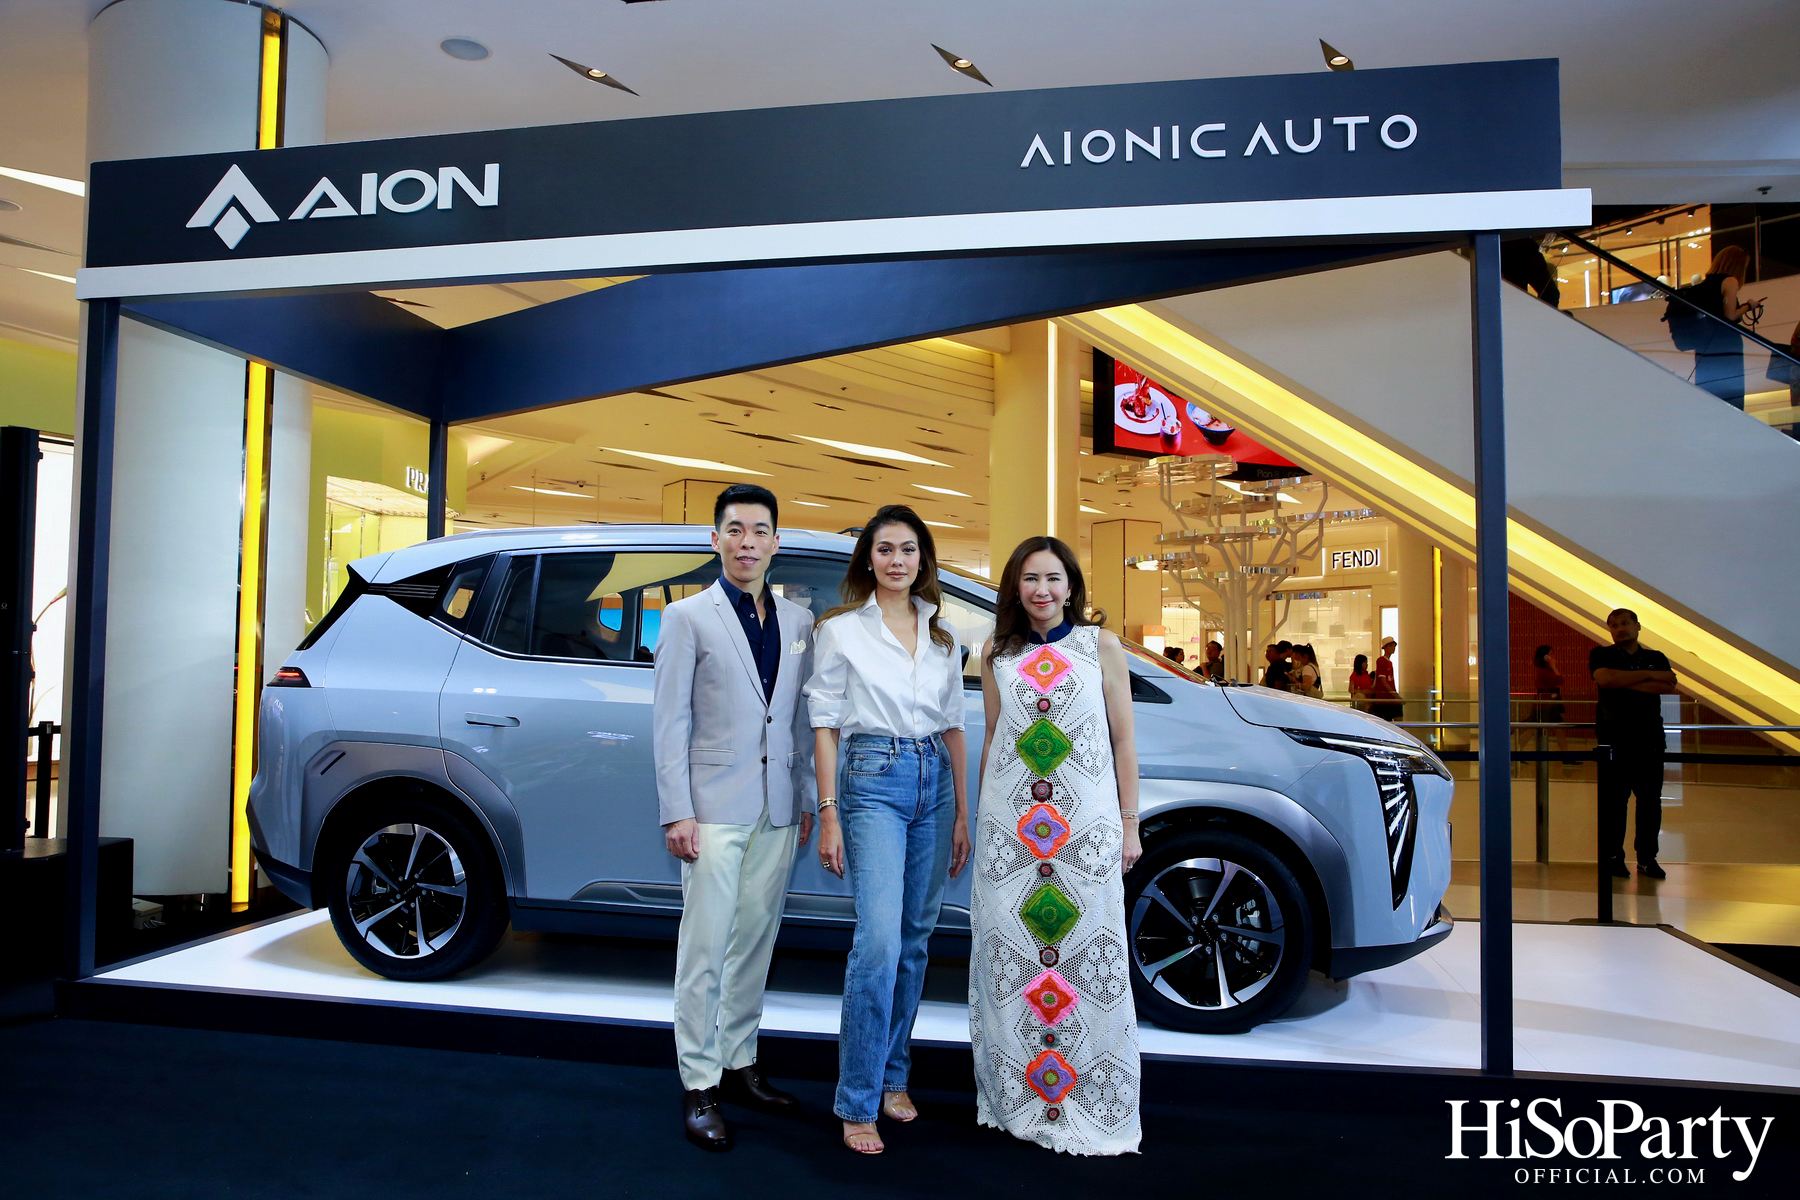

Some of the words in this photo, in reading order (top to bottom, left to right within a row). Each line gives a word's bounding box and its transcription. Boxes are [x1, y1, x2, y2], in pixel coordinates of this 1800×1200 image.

[1020, 122, 1227, 168] AIONIC
[1243, 114, 1418, 157] AUTO
[287, 162, 500, 220] AION
[1332, 548, 1380, 570] FENDI
